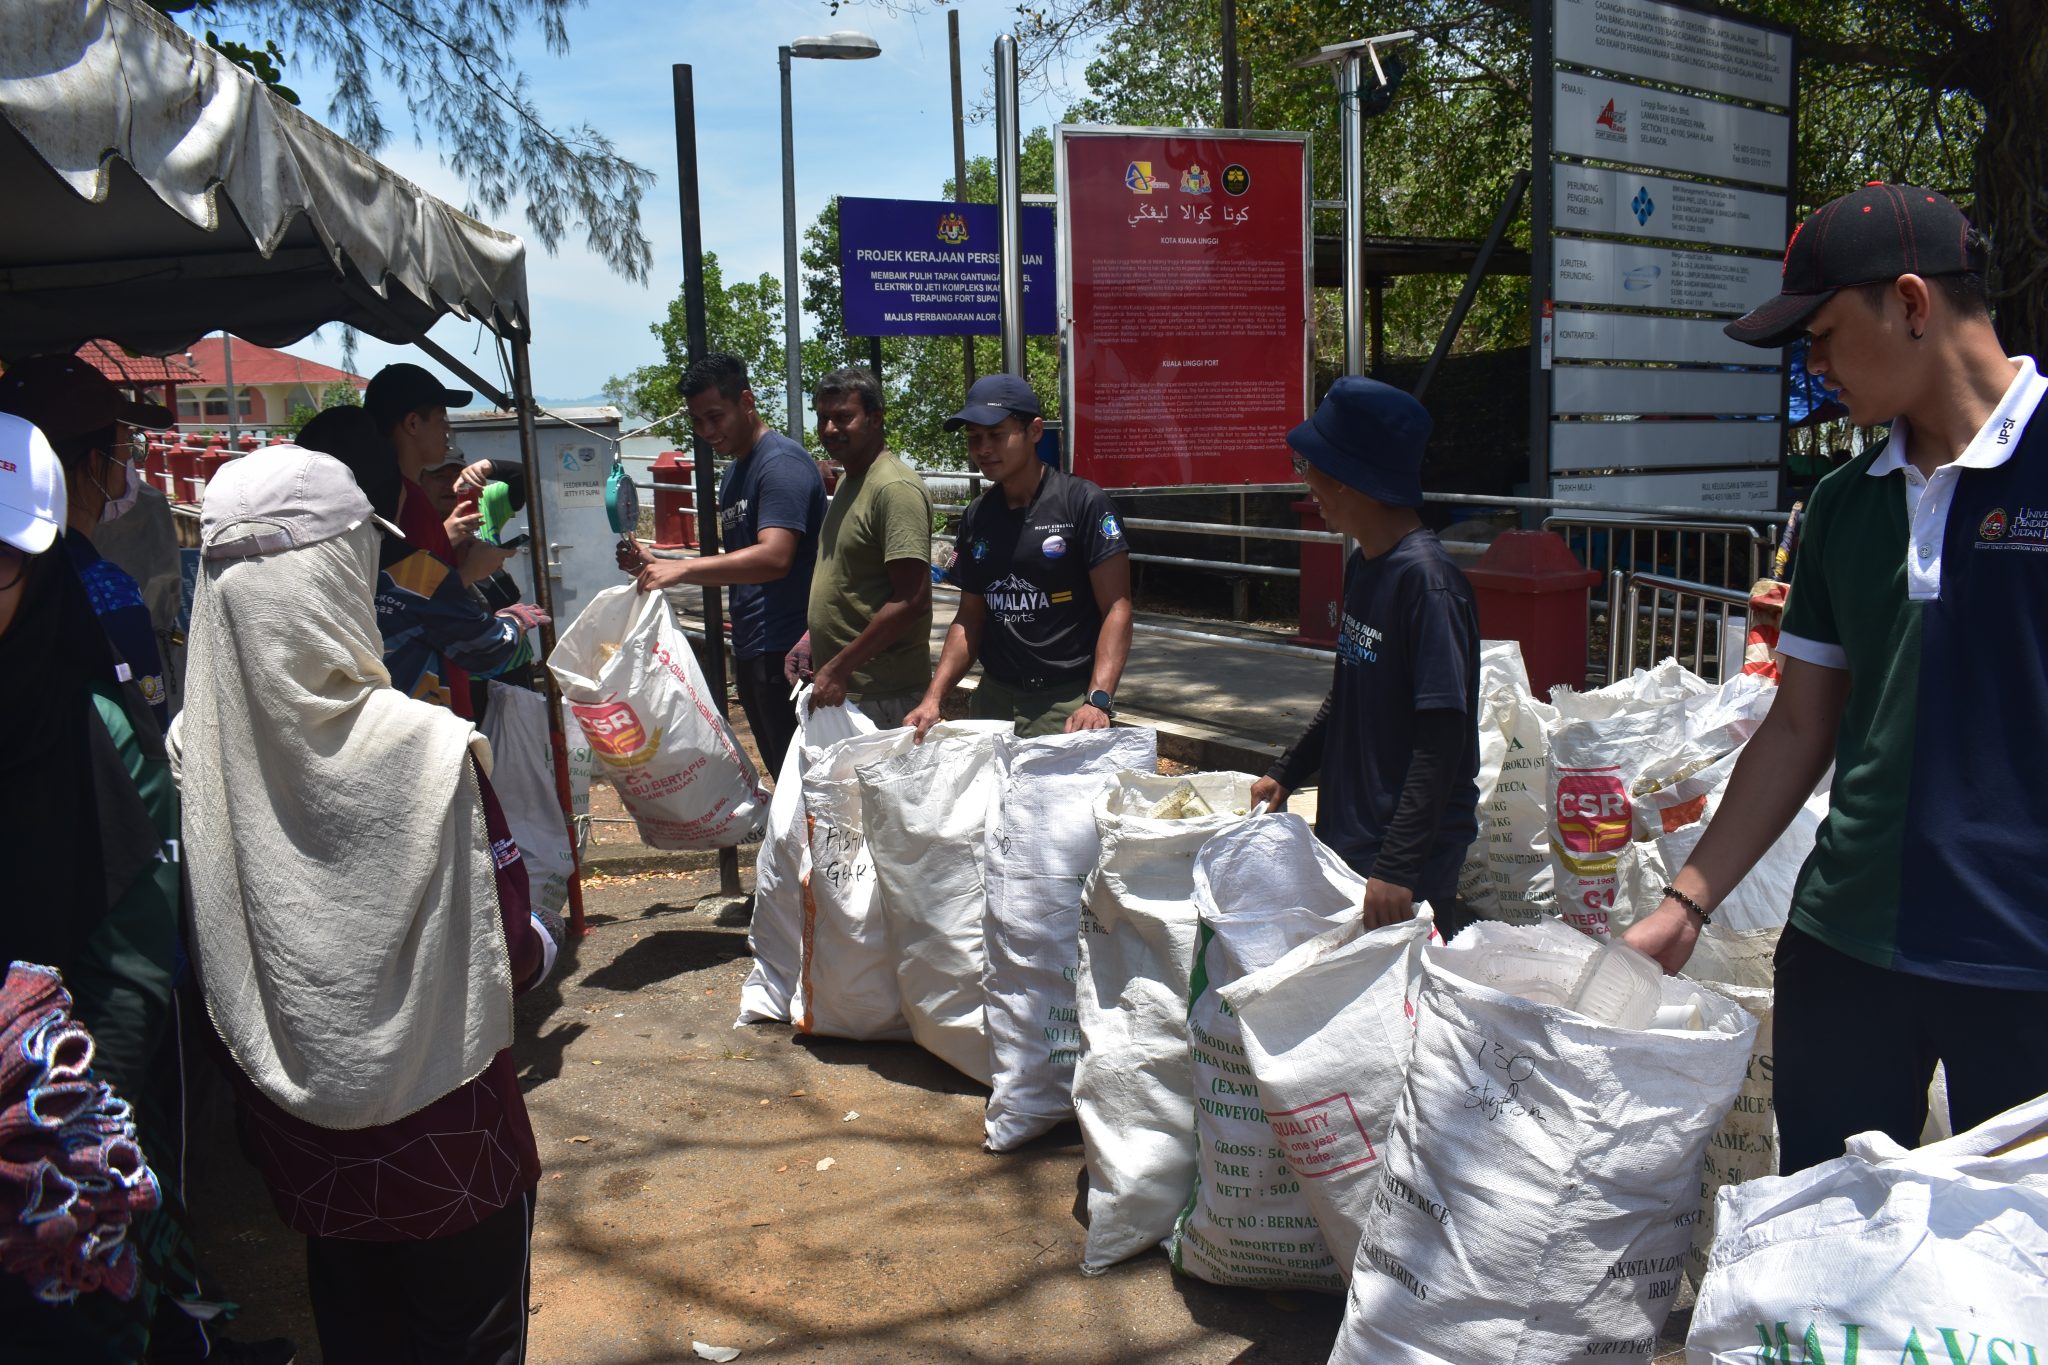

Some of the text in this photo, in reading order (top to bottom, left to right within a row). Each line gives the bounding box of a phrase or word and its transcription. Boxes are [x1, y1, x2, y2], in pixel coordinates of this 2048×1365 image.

[1596, 12, 1607, 22] DAN
[1596, 24, 1626, 38] CADANGAN
[1567, 181, 1599, 193] PERUNDING
[1567, 193, 1603, 205] PENGURUSAN
[1179, 204, 1212, 225] كوالا
[1223, 205, 1250, 225] كوتا
[1161, 237, 1219, 245] KOTA KUALA LINGGI
[857, 249, 1043, 266] PROJEK KERAJAAN PERSEUAN
[1560, 259, 1587, 268] JURUTERA
[870, 271, 1001, 282] MEMBAIK PULIH TAPAK GANTUNGA
[875, 283, 914, 291] ELEKTRIK
[915, 283, 923, 291] DI
[924, 284, 941, 292] JETI
[942, 285, 984, 293] KOMPLEKS
[911, 294, 953, 302] TERAPUNG
[885, 313, 913, 321] MAJLIS
[915, 313, 975, 322] PERBANDARAN
[976, 314, 997, 322] ALOR
[1162, 359, 1219, 368] KUALA LINGGI PORT
[1996, 418, 2016, 445] UPSI
[580, 480, 599, 488] PILLAR
[2008, 525, 2041, 538] SULTAN
[984, 592, 1050, 611] HIMALAYA
[994, 611, 1036, 626] Sports
[579, 709, 635, 736] CSR
[1501, 758, 1532, 772] BROKEN
[652, 757, 707, 791] BERTAPIS
[1494, 801, 1507, 812] KG
[1559, 793, 1625, 818] CSR
[1498, 817, 1511, 828] KG
[1578, 878, 1596, 886] Since
[1583, 888, 1615, 909] C1
[1573, 913, 1608, 926] TEBU
[1043, 1028, 1059, 1043] NO
[1734, 1096, 1766, 1113] RICE
[1272, 1111, 1329, 1137] QUALITY
[1291, 1132, 1338, 1152] one year
[1306, 1152, 1334, 1166] date.
[1214, 1160, 1250, 1178] TARE
[1216, 1182, 1252, 1198] NETT
[1418, 1194, 1452, 1226] RICE
[1238, 1216, 1257, 1229] NO
[1229, 1238, 1316, 1253] IMPORTED BY
[1231, 1250, 1335, 1269] NASIONAL BERHAD
[1384, 1253, 1429, 1301] VERITAS
